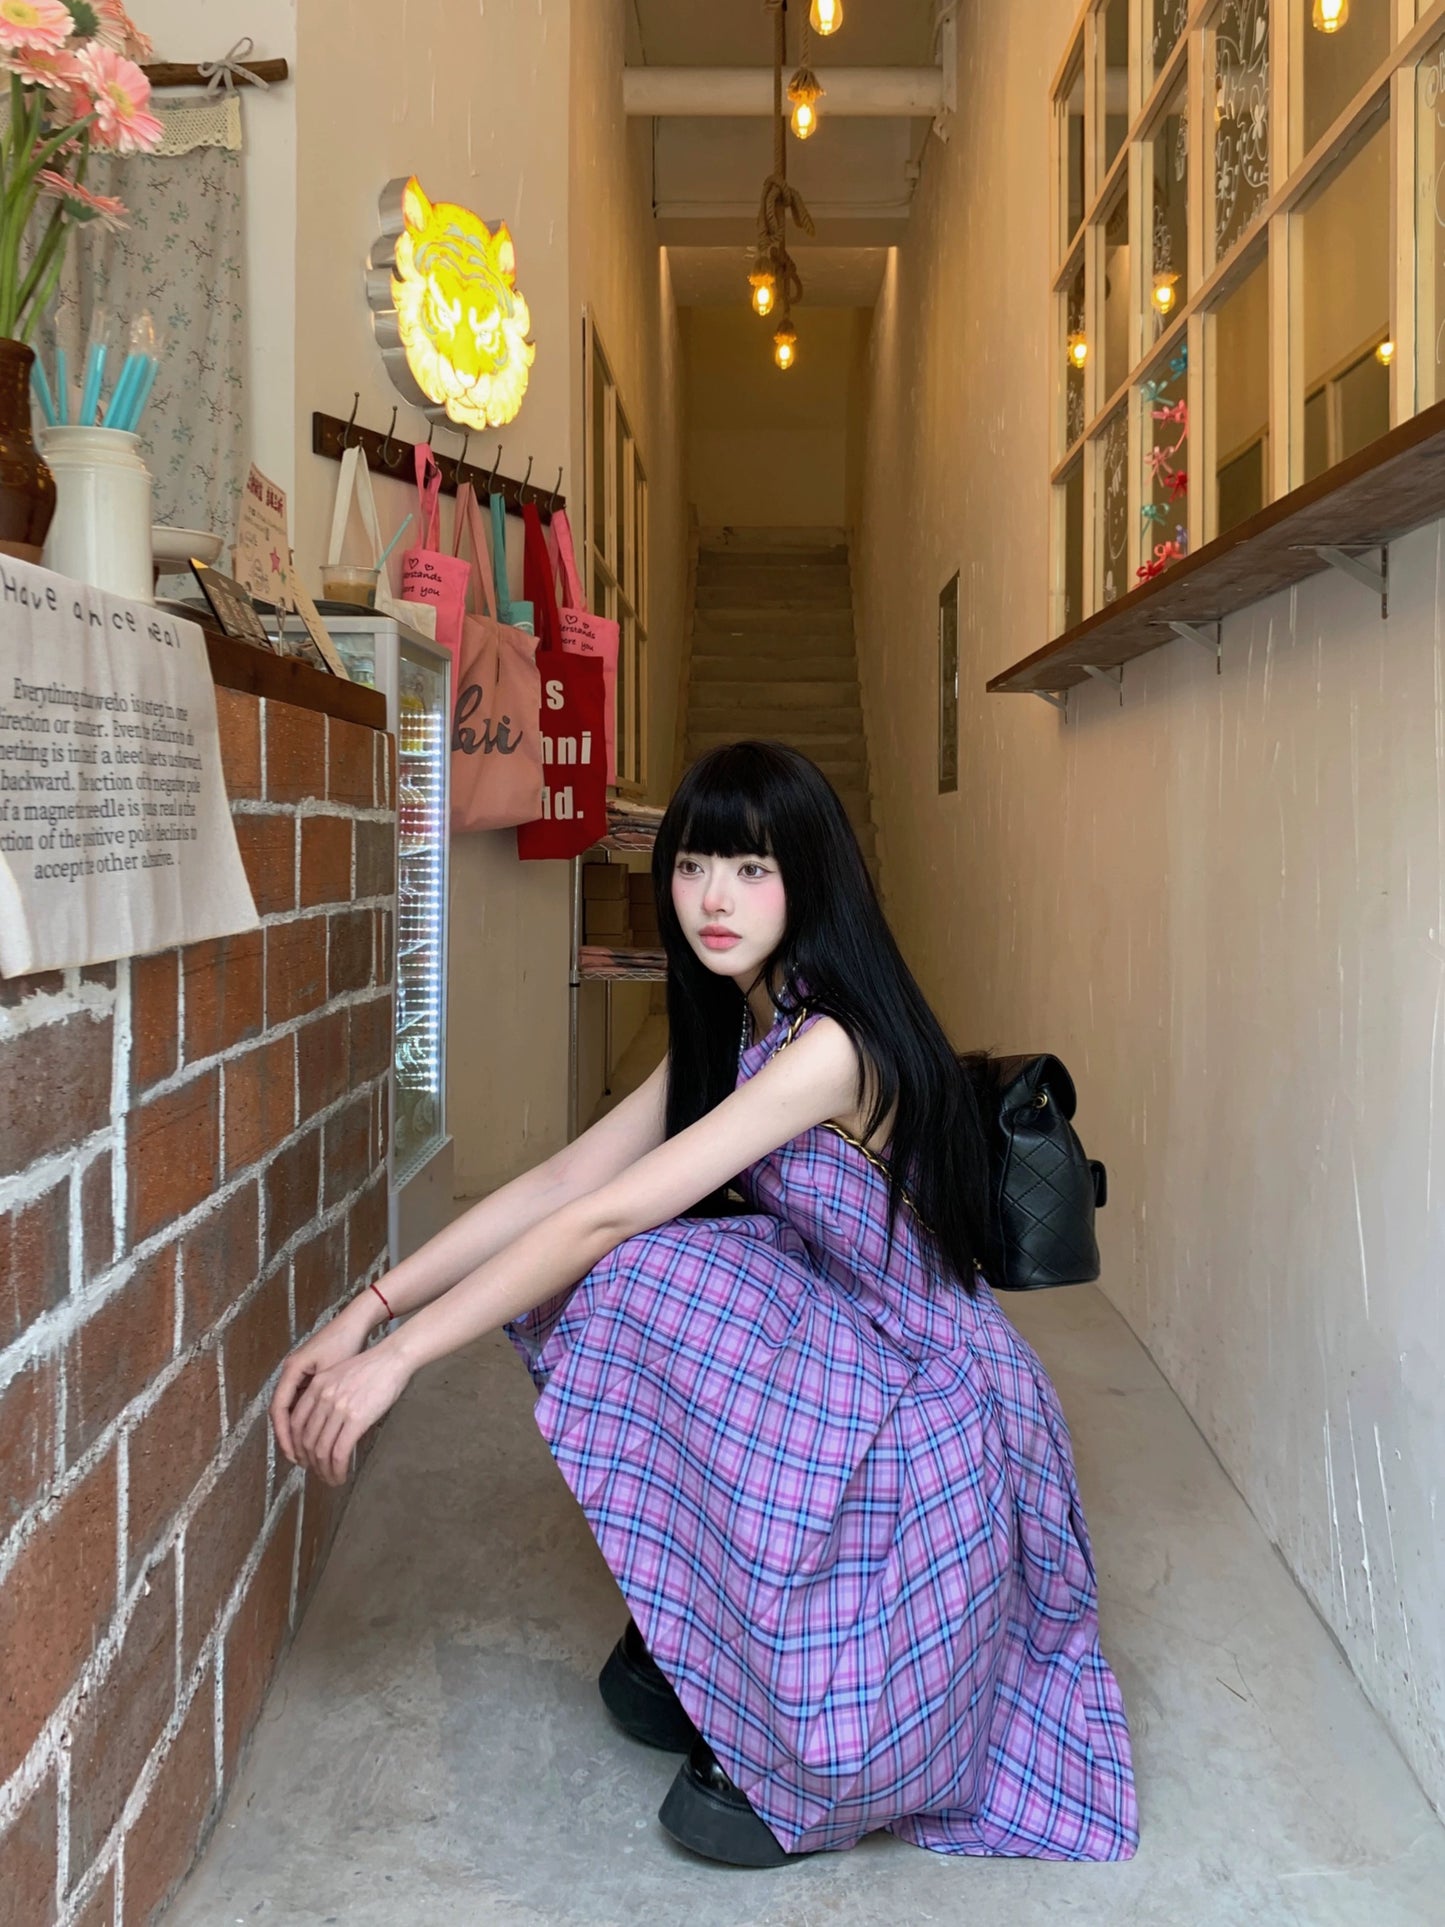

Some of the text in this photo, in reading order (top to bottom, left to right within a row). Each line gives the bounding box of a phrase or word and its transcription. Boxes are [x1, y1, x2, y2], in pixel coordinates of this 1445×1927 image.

[420, 586, 440, 597] you
[0, 564, 57, 611] Have
[148, 621, 181, 649] eal
[13, 677, 80, 712] Everything
[539, 680, 565, 710] s
[0, 706, 50, 733] irection
[54, 718, 70, 734] or
[52, 741, 65, 763] is
[101, 750, 112, 765] a
[1, 769, 76, 792] backward.
[12, 805, 20, 821] a
[127, 798, 141, 817] is
[0, 829, 34, 852] ction
[39, 827, 55, 850] of
[59, 828, 81, 849] the
[96, 851, 138, 874] other
